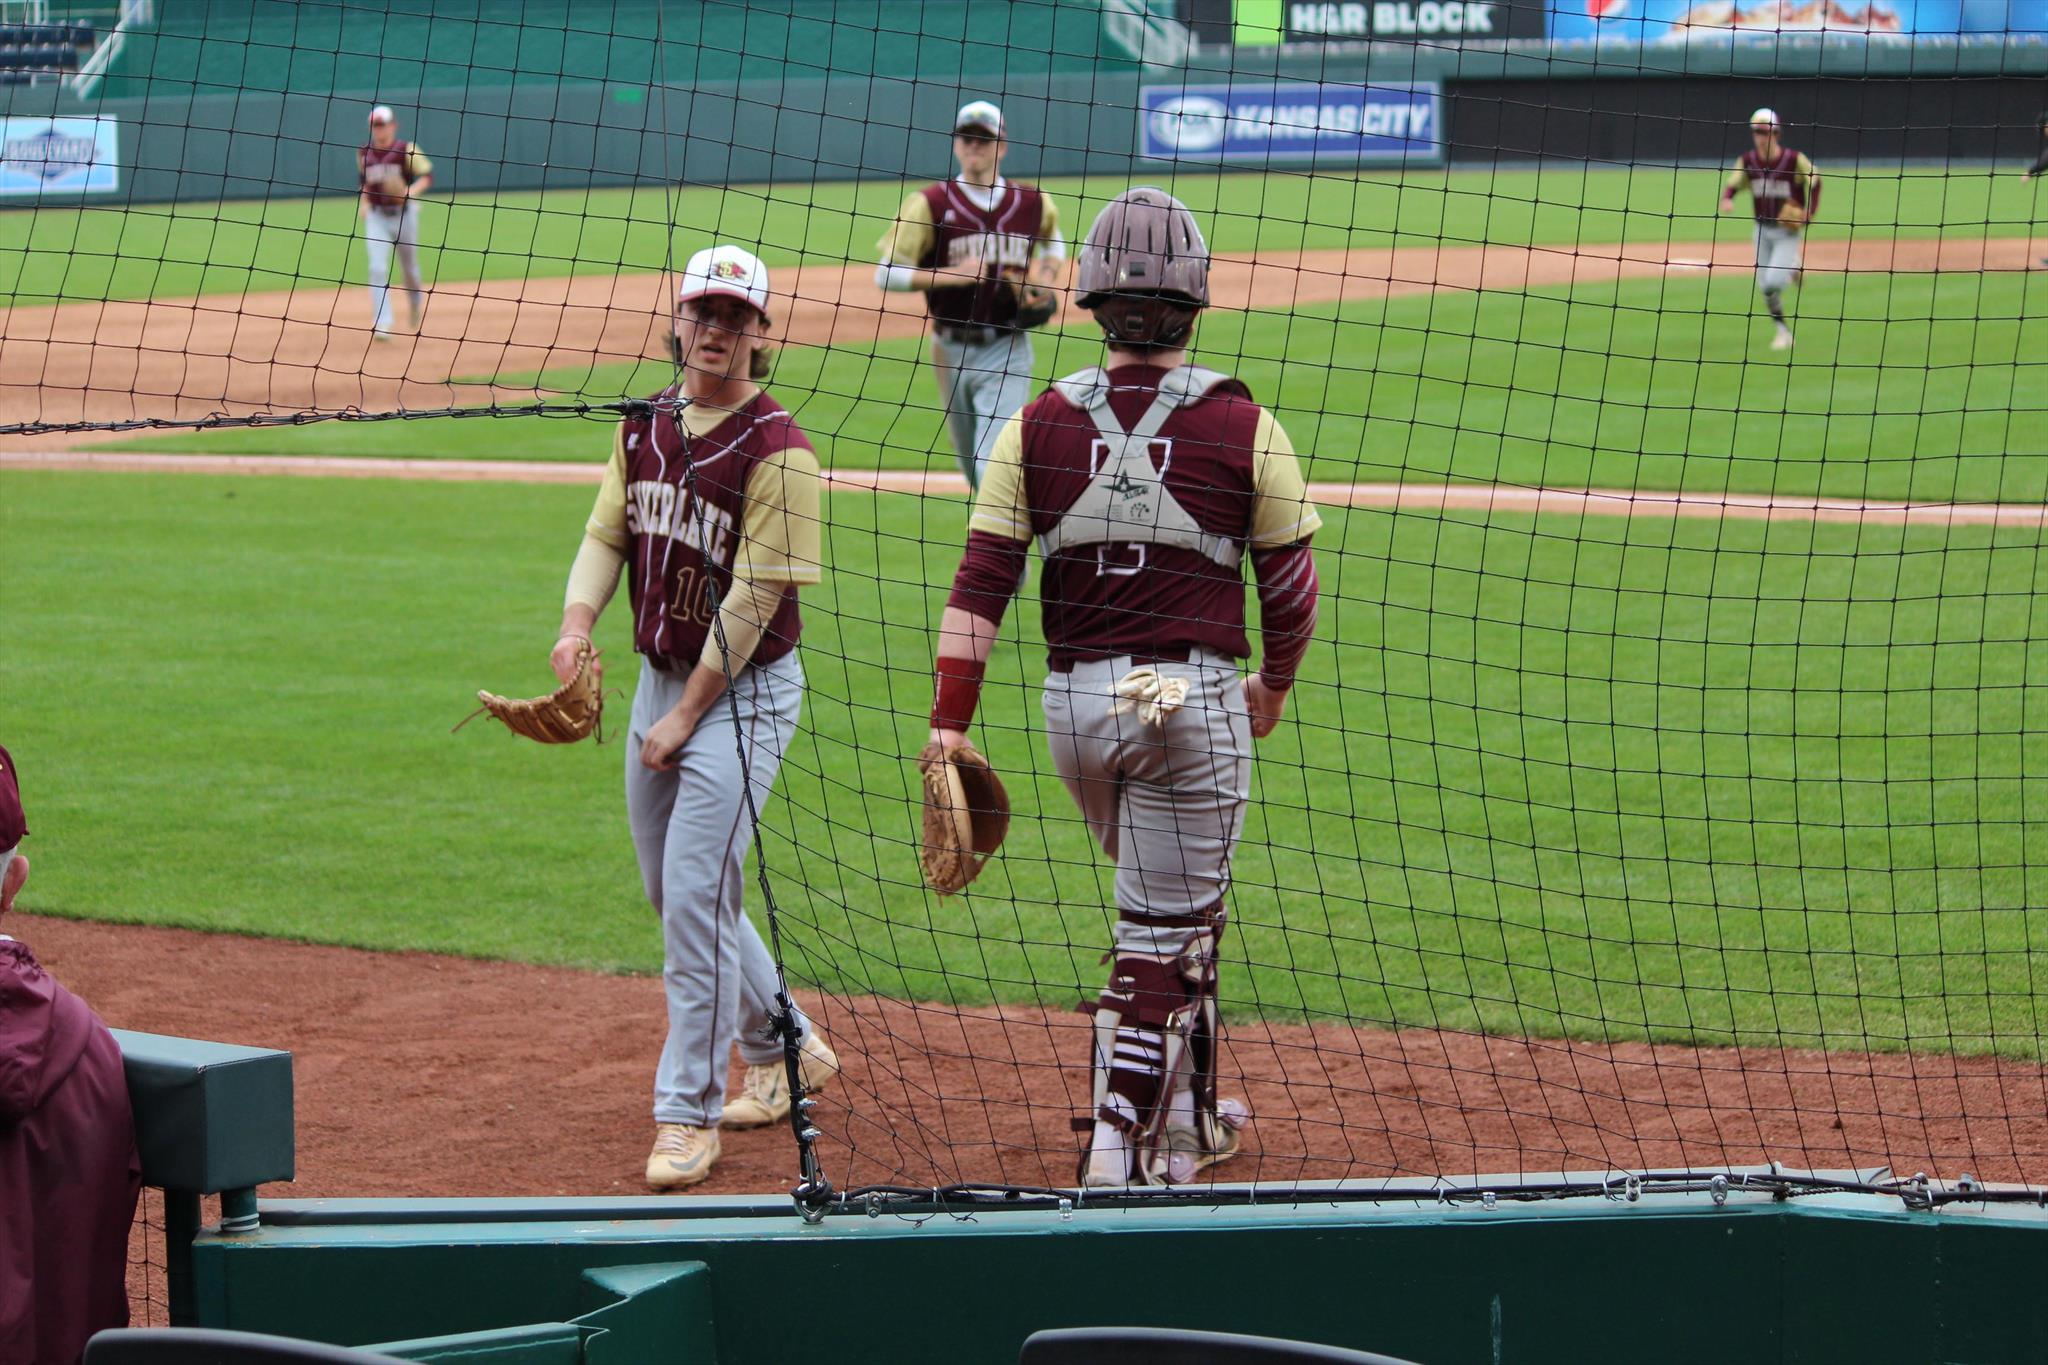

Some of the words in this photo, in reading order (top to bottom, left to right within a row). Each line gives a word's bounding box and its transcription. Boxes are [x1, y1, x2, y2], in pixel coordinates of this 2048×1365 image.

[1290, 3, 1367, 34] H&R
[1373, 2, 1492, 33] BLOCK
[1233, 105, 1358, 138] KANSAS
[1360, 103, 1429, 135] CITY
